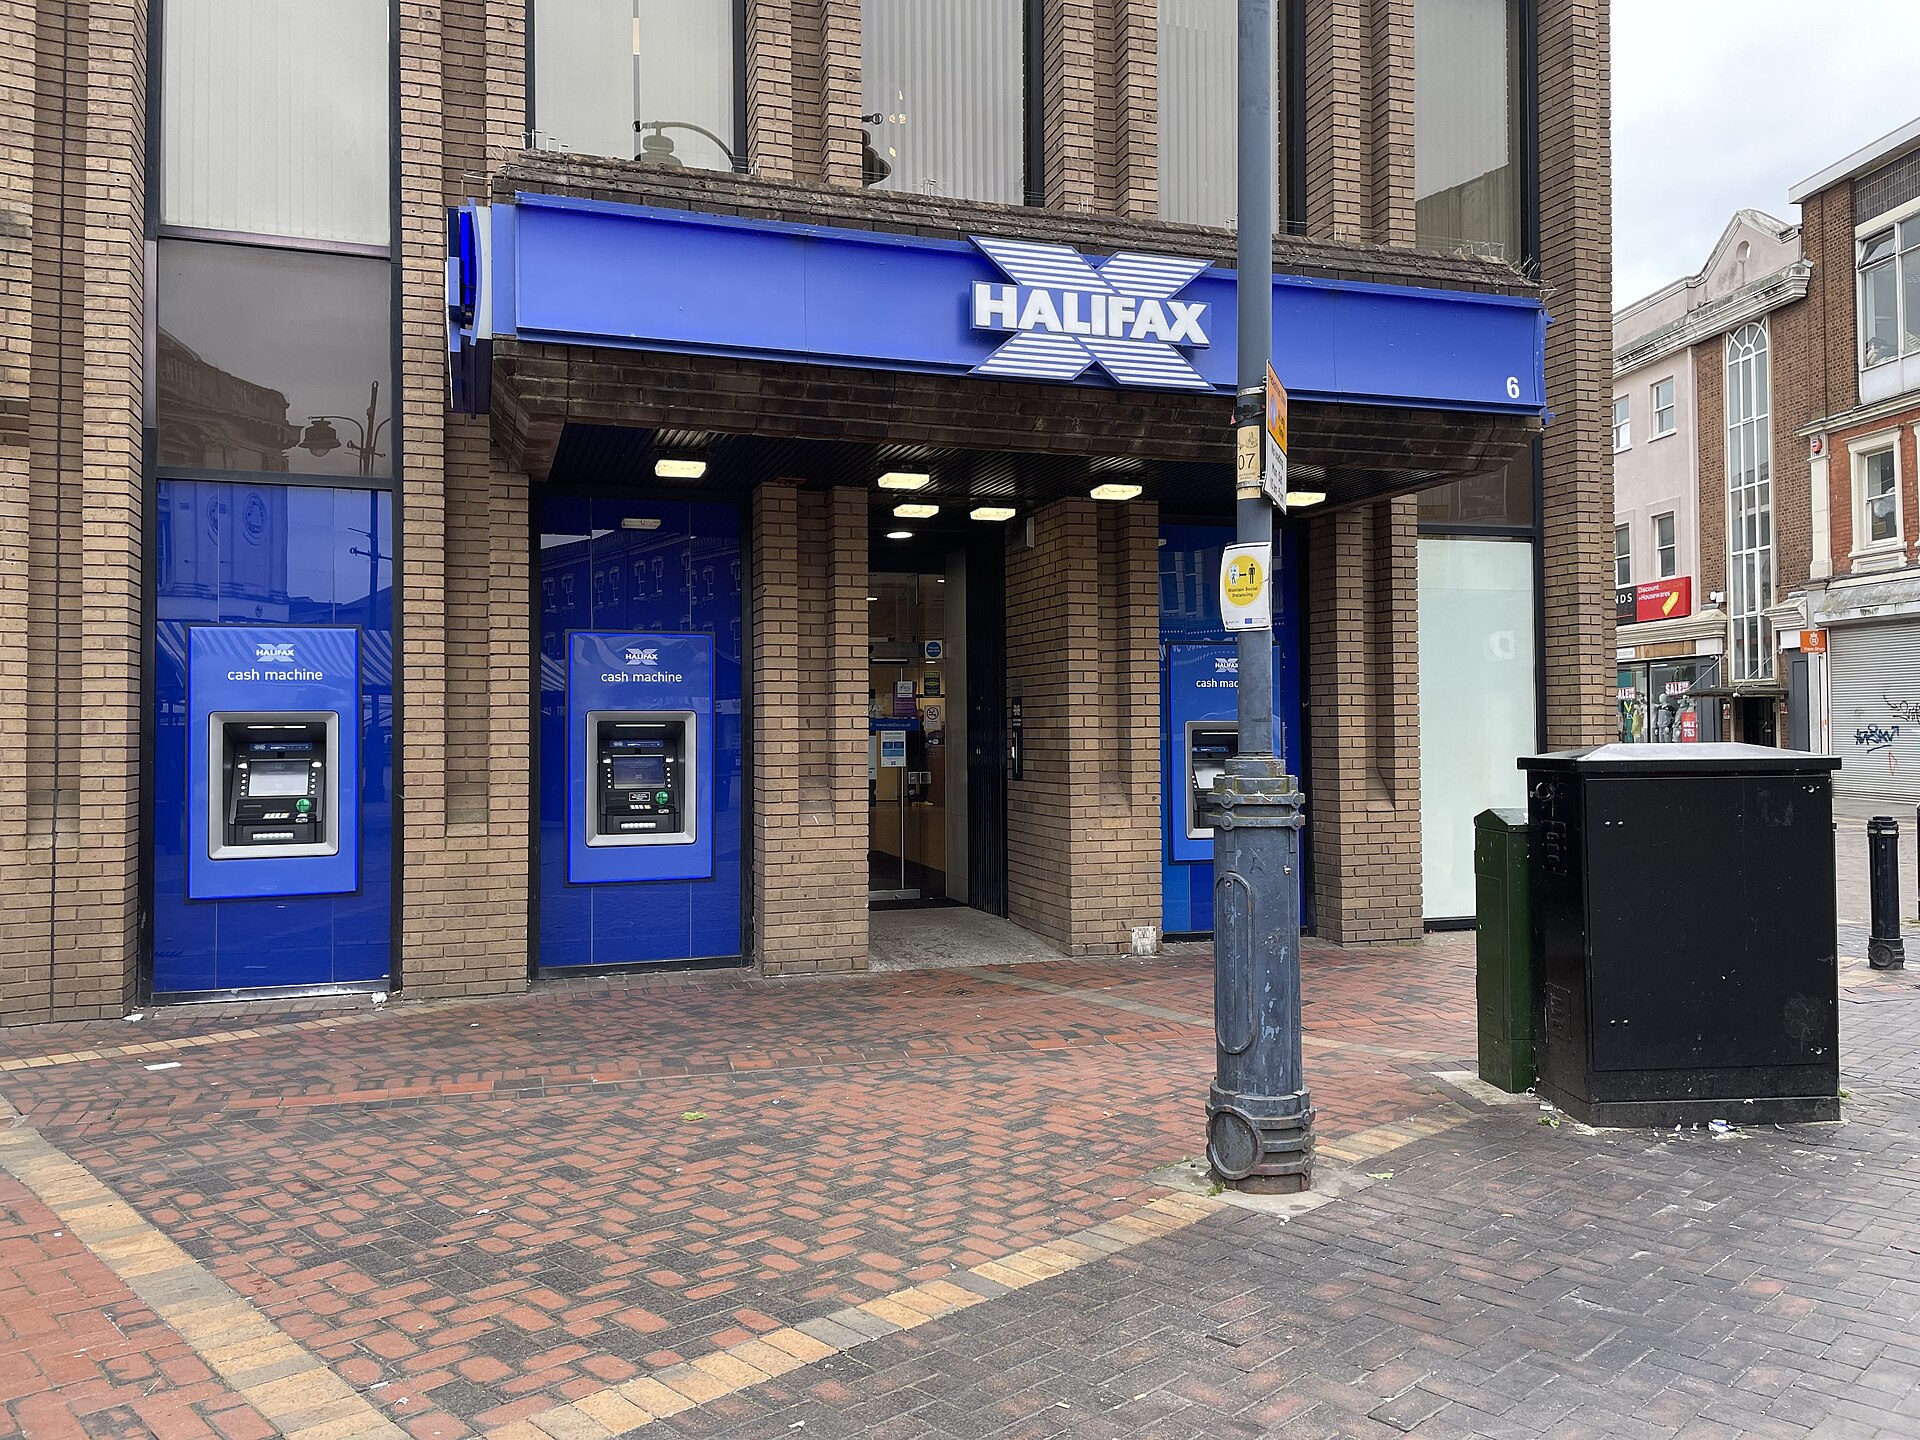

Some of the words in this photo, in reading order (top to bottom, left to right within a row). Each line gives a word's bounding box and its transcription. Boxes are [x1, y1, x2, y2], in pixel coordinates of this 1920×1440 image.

[975, 283, 1210, 345] HALIFAX
[1506, 376, 1520, 399] 6
[1238, 452, 1256, 471] 07
[1637, 584, 1660, 594] Discount
[256, 649, 295, 657] HALIFAX
[227, 668, 260, 681] cash
[264, 668, 323, 681] machine
[601, 671, 629, 683] cash
[633, 671, 683, 683] machine
[1196, 678, 1217, 688] cash
[1665, 682, 1681, 695] SALE
[1617, 688, 1629, 700] ALE
